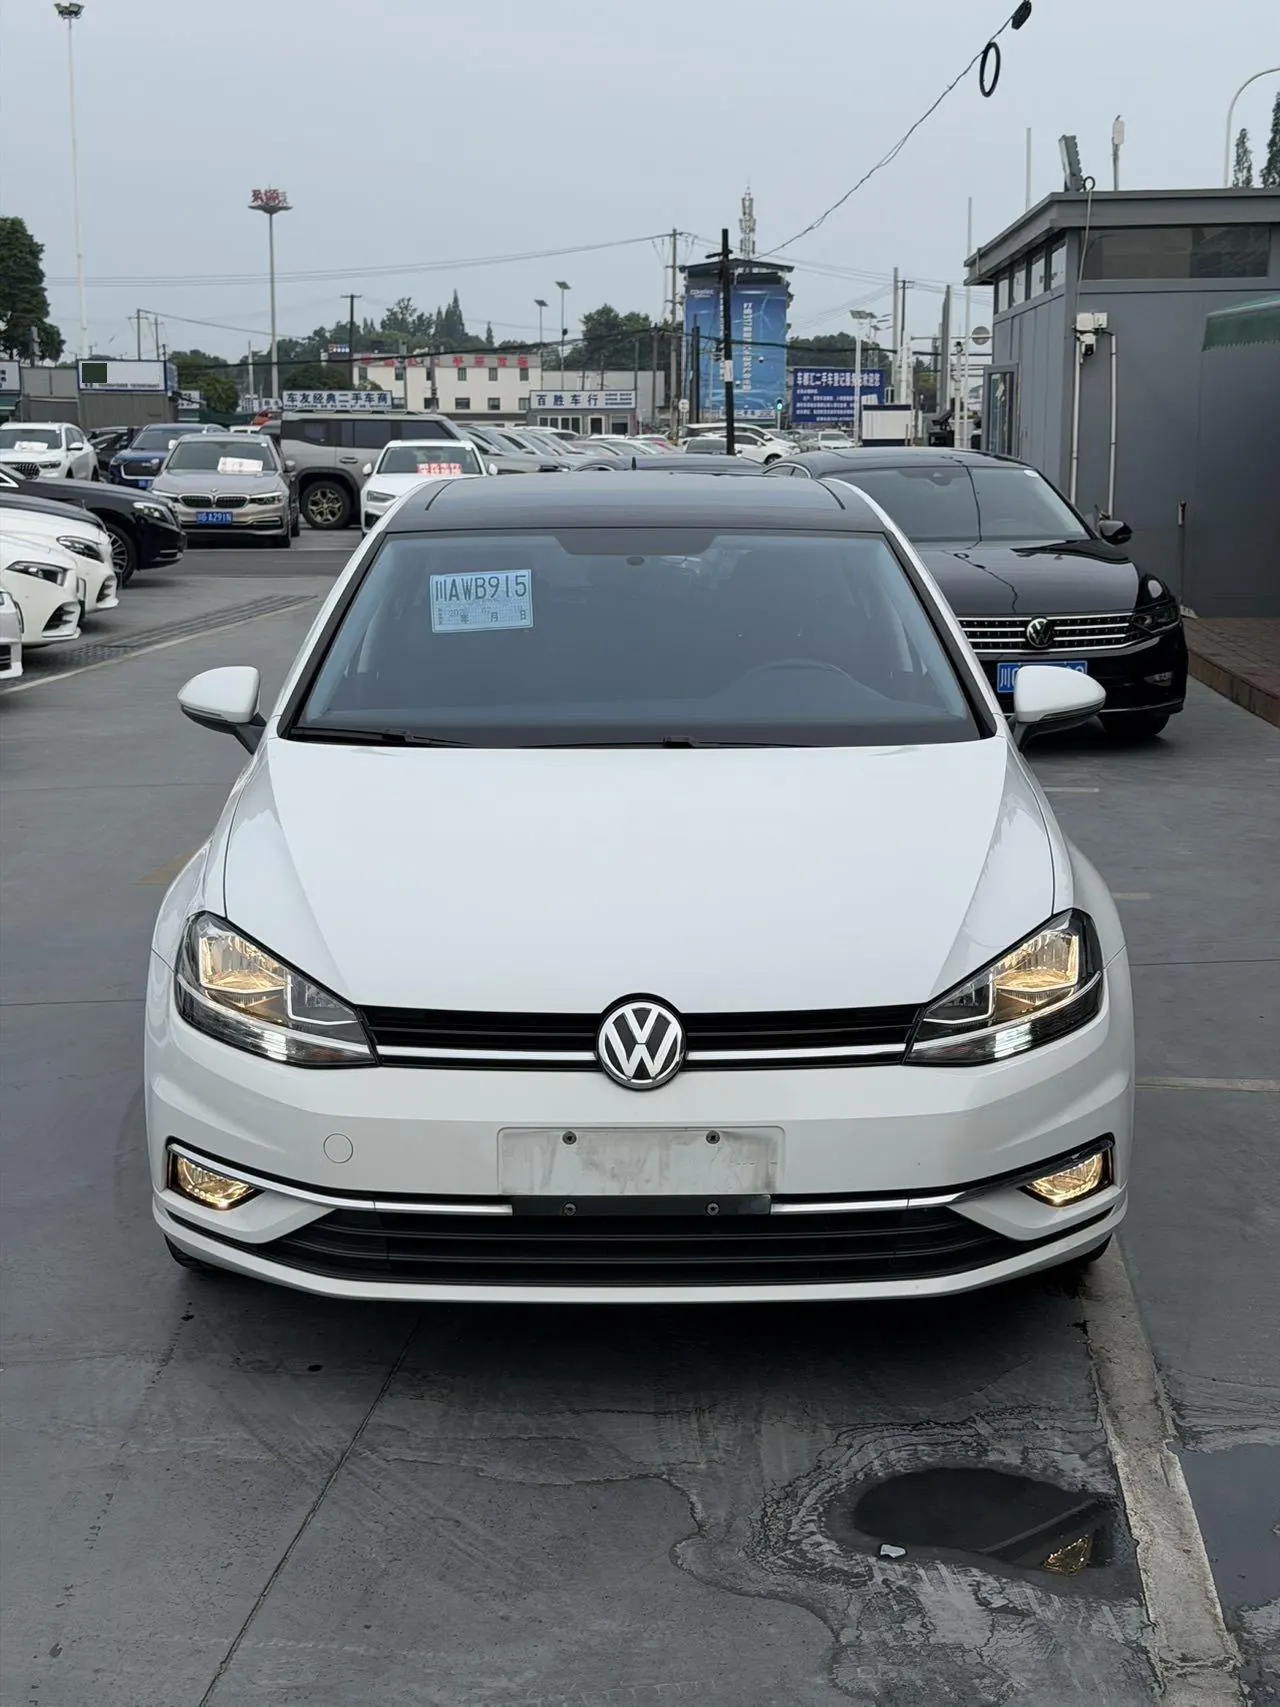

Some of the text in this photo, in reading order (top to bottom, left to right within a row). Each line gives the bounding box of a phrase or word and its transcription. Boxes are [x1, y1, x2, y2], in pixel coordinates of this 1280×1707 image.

[286, 393, 389, 404] 车友经典二手车商
[536, 394, 598, 406] 百胜车行
[435, 574, 527, 601] 川AWB915
[490, 611, 498, 622] 月
[520, 610, 526, 620] 日
[600, 1003, 681, 1083] VW
